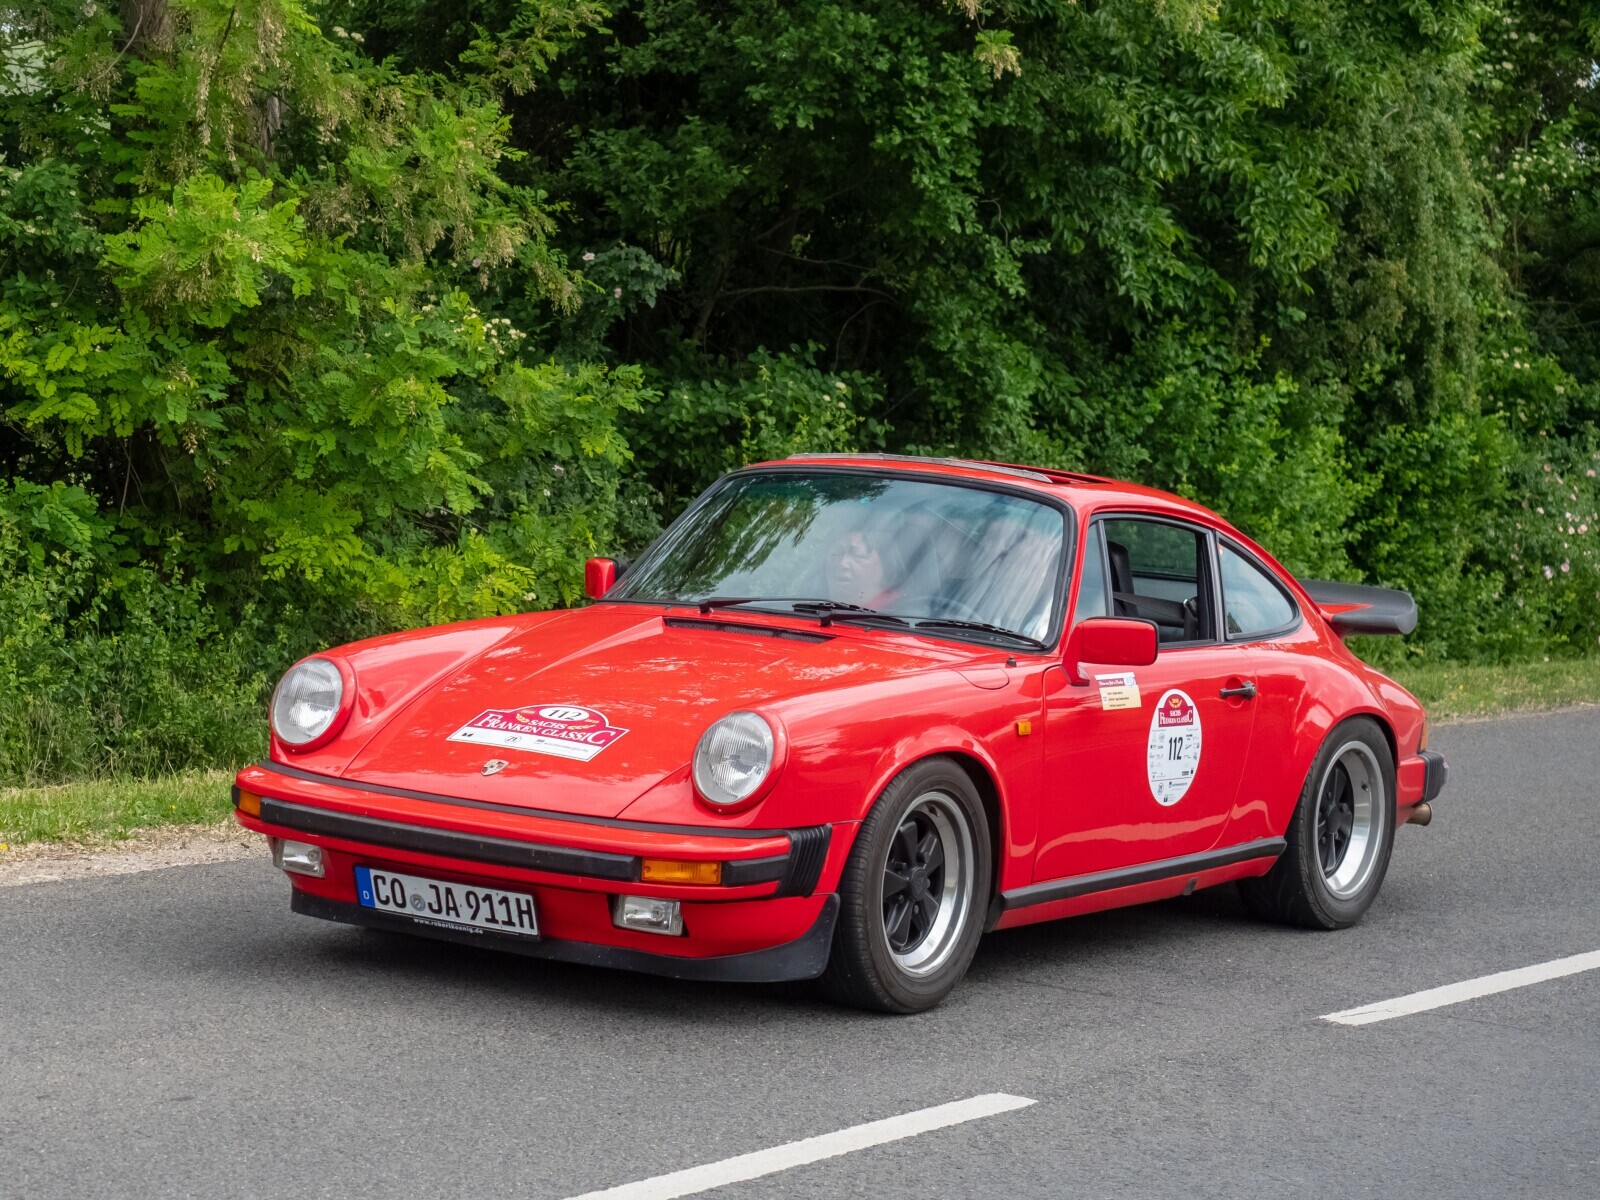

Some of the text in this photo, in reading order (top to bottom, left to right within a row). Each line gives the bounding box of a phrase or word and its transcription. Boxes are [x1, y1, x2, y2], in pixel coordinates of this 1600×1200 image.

[548, 709, 582, 720] 112
[474, 713, 616, 745] FRANKEN CLASSIC
[528, 719, 568, 730] SACHS
[1168, 736, 1184, 761] 112
[363, 890, 370, 900] D
[373, 874, 535, 930] CO JA 911H
